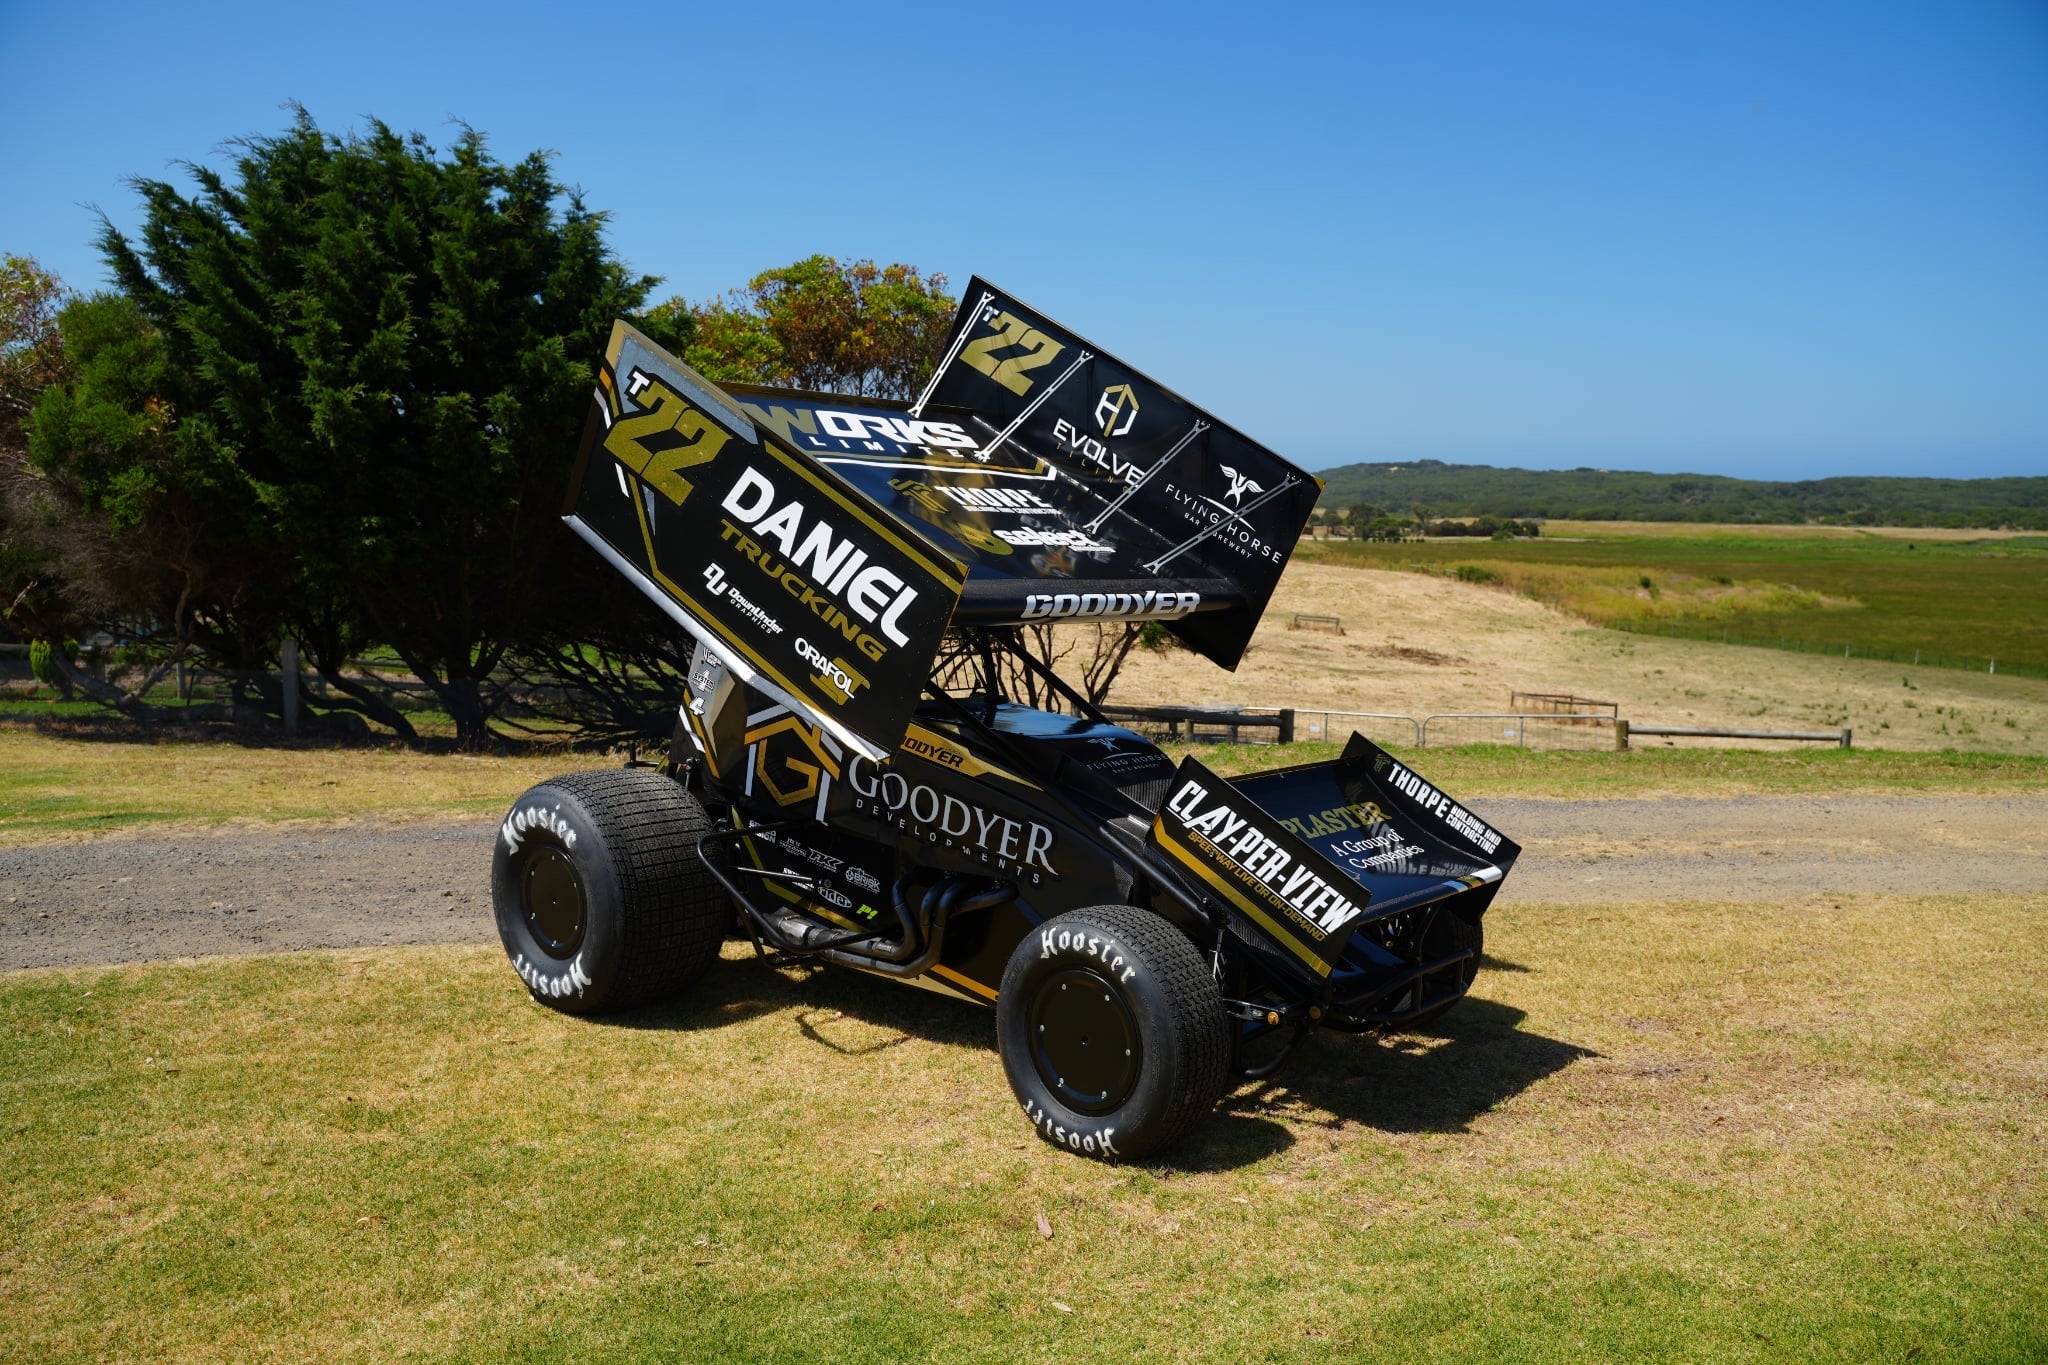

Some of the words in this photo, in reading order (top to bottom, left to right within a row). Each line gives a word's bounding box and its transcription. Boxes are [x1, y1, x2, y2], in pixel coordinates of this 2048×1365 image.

[809, 436, 966, 458] LIMITE
[1053, 418, 1146, 488] EVOLVE
[934, 486, 1052, 508] THORPE
[1184, 513, 1199, 526] BAR
[1165, 483, 1220, 524] FLYING
[1227, 524, 1282, 564] HORSE
[721, 466, 918, 648] DANIEL
[720, 519, 887, 662] TRUCKING
[728, 587, 784, 635] DownUnder
[730, 598, 772, 634] GRAPHICS
[1021, 591, 1200, 618] GOODYER
[794, 637, 855, 699] ORAFOL
[502, 804, 577, 856] Hoosier
[849, 754, 1059, 875] GOODYER
[1279, 801, 1393, 839] PLASTER
[1388, 763, 1451, 819] THORPE
[1449, 804, 1486, 834] BUILDING
[1484, 828, 1502, 847] AND
[856, 799, 1040, 884] DEVELOPMENTS
[1169, 779, 1362, 934] CLAY-PER-VIEW
[1330, 842, 1344, 857] A
[1343, 832, 1391, 855] Group
[1387, 828, 1405, 842] of
[1348, 843, 1424, 869] Companies
[1445, 814, 1496, 855] CONTRACTING
[819, 887, 852, 907] rider
[1234, 867, 1255, 887] LIVE
[1253, 884, 1270, 899] OR
[1268, 896, 1327, 943] ON-DEMAND
[513, 952, 592, 999] Hoosier
[1040, 925, 1136, 983] Hoosier
[1022, 1099, 1120, 1158] Hoosier
